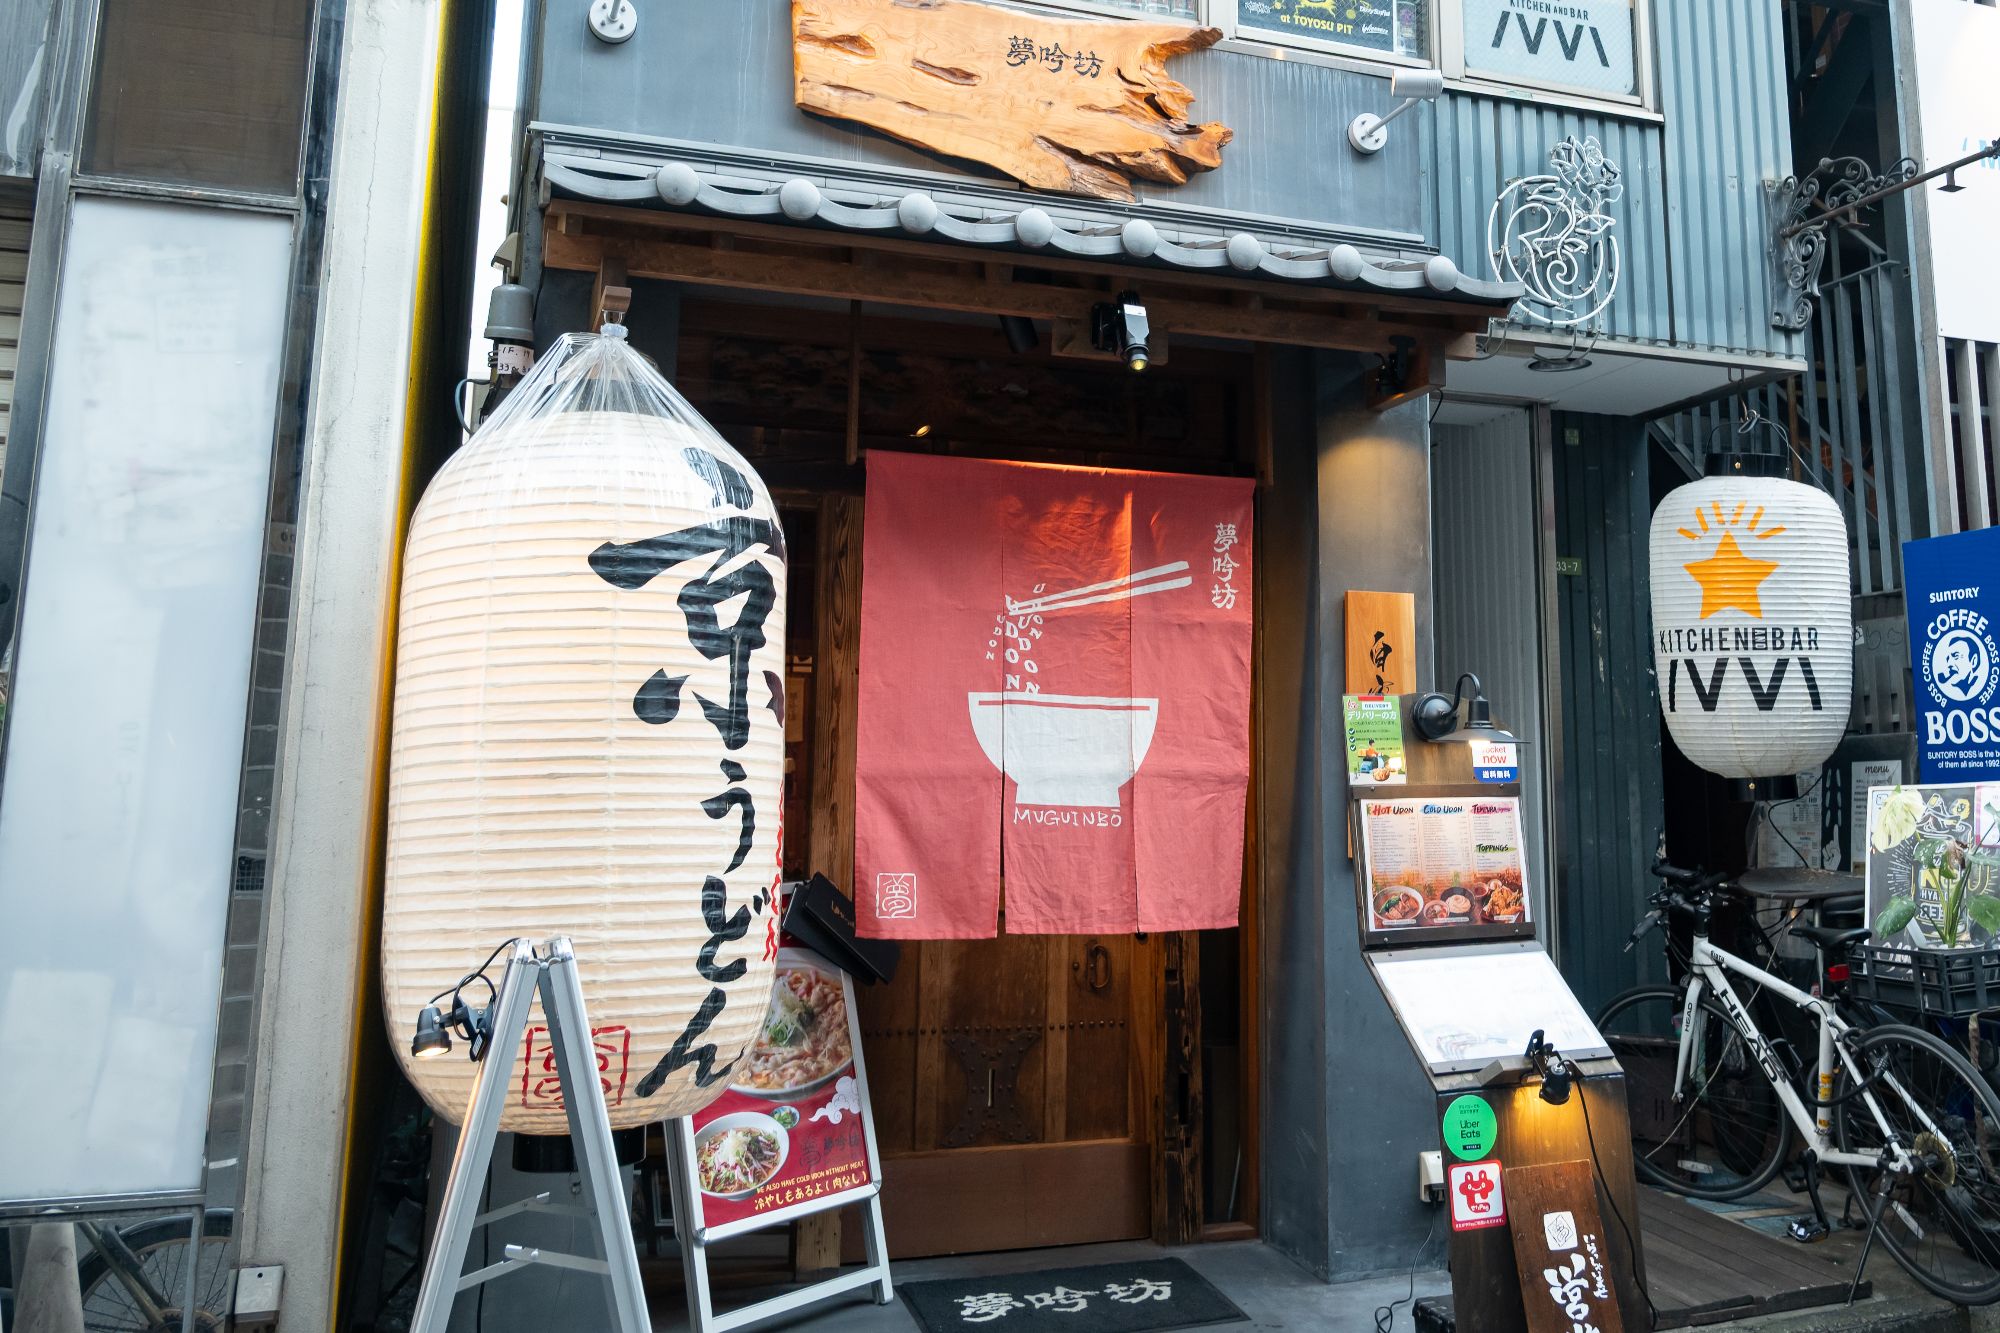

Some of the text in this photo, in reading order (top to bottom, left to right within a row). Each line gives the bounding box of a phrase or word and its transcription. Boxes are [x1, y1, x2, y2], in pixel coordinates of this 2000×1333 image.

[1554, 6, 1568, 15] AND
[1570, 8, 1589, 20] BAR
[1281, 14, 1290, 23] at
[1294, 15, 1334, 31] TOYOSU
[1336, 23, 1353, 34] PIT
[1006, 35, 1104, 79] 夢吟坊
[1212, 522, 1239, 609] 夢吟坊
[1929, 587, 1979, 604] SUNTORY
[1927, 609, 1989, 640] COFFEE
[1660, 627, 1749, 653] KITCHEN
[1772, 627, 1819, 650] BAR
[1922, 642, 1947, 708] BOSS COFFEE
[1979, 634, 2000, 705] BOSS COFFEE
[1348, 710, 1397, 720] デリバリーの方
[1924, 707, 2000, 745] BOSS
[1483, 755, 1507, 764] now
[1927, 751, 1957, 760] SUNTORY
[1959, 750, 1976, 758] BOSS
[1984, 750, 1994, 758] the
[1945, 760, 1959, 768] them
[1968, 759, 1983, 768] since
[1865, 765, 1889, 774] menu
[1372, 804, 1413, 816] HOT UDON
[1423, 804, 1463, 814] COLD UDON
[1476, 843, 1509, 853] TOPPINGS
[1685, 1002, 1693, 1032] HEAD
[1720, 989, 1778, 1083] HEAD
[1460, 1119, 1480, 1129] Uber
[1460, 1130, 1481, 1139] Eats
[766, 1182, 780, 1191] ALSO
[780, 1178, 796, 1187] HAVE
[796, 1174, 811, 1183] COLD
[811, 1170, 825, 1180] UDON
[825, 1164, 849, 1176] WITHOUT
[850, 1160, 865, 1170] MEAT
[954, 1279, 1172, 1322] 夢吟坊
[1543, 1252, 1602, 1333] 営
